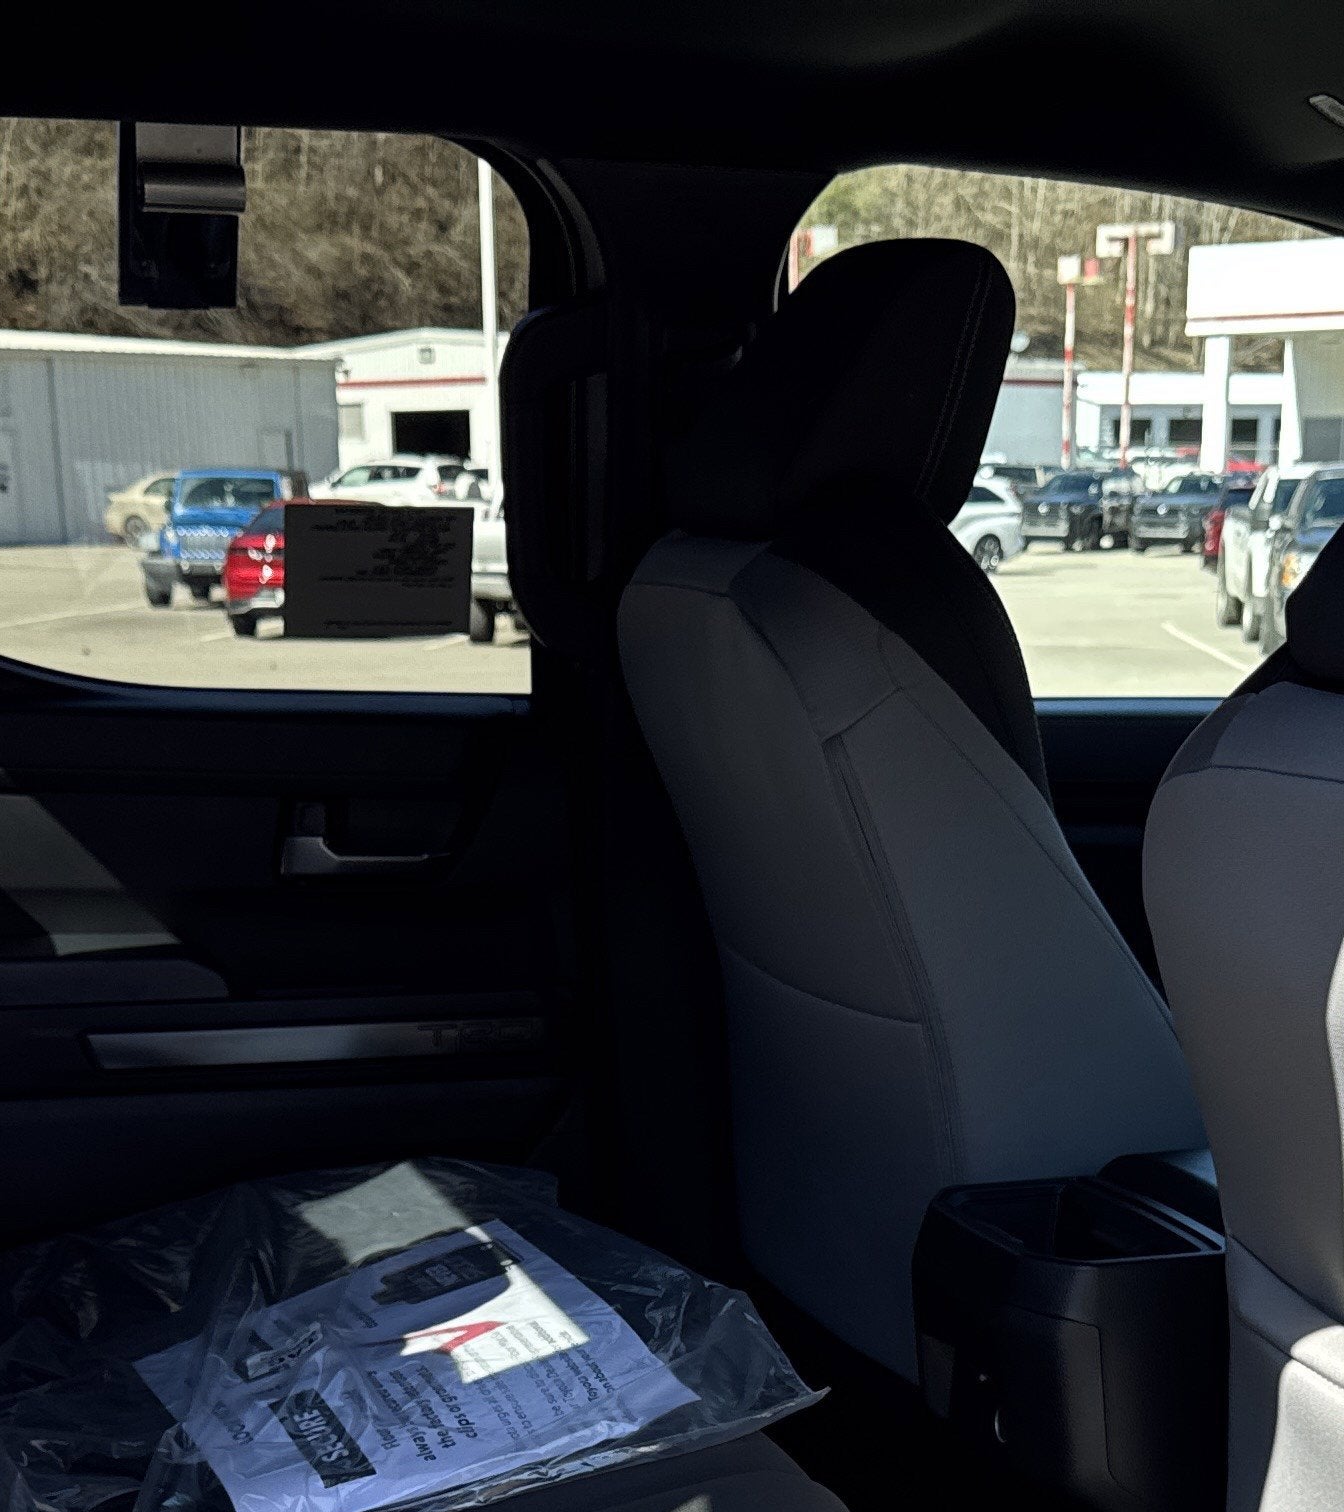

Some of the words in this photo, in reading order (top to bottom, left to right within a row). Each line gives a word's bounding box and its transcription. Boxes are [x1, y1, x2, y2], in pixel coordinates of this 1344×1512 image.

[293, 1409, 350, 1462] SECURE
[437, 1428, 456, 1448] the
[454, 1413, 478, 1439] clips
[376, 1428, 400, 1450] Floor
